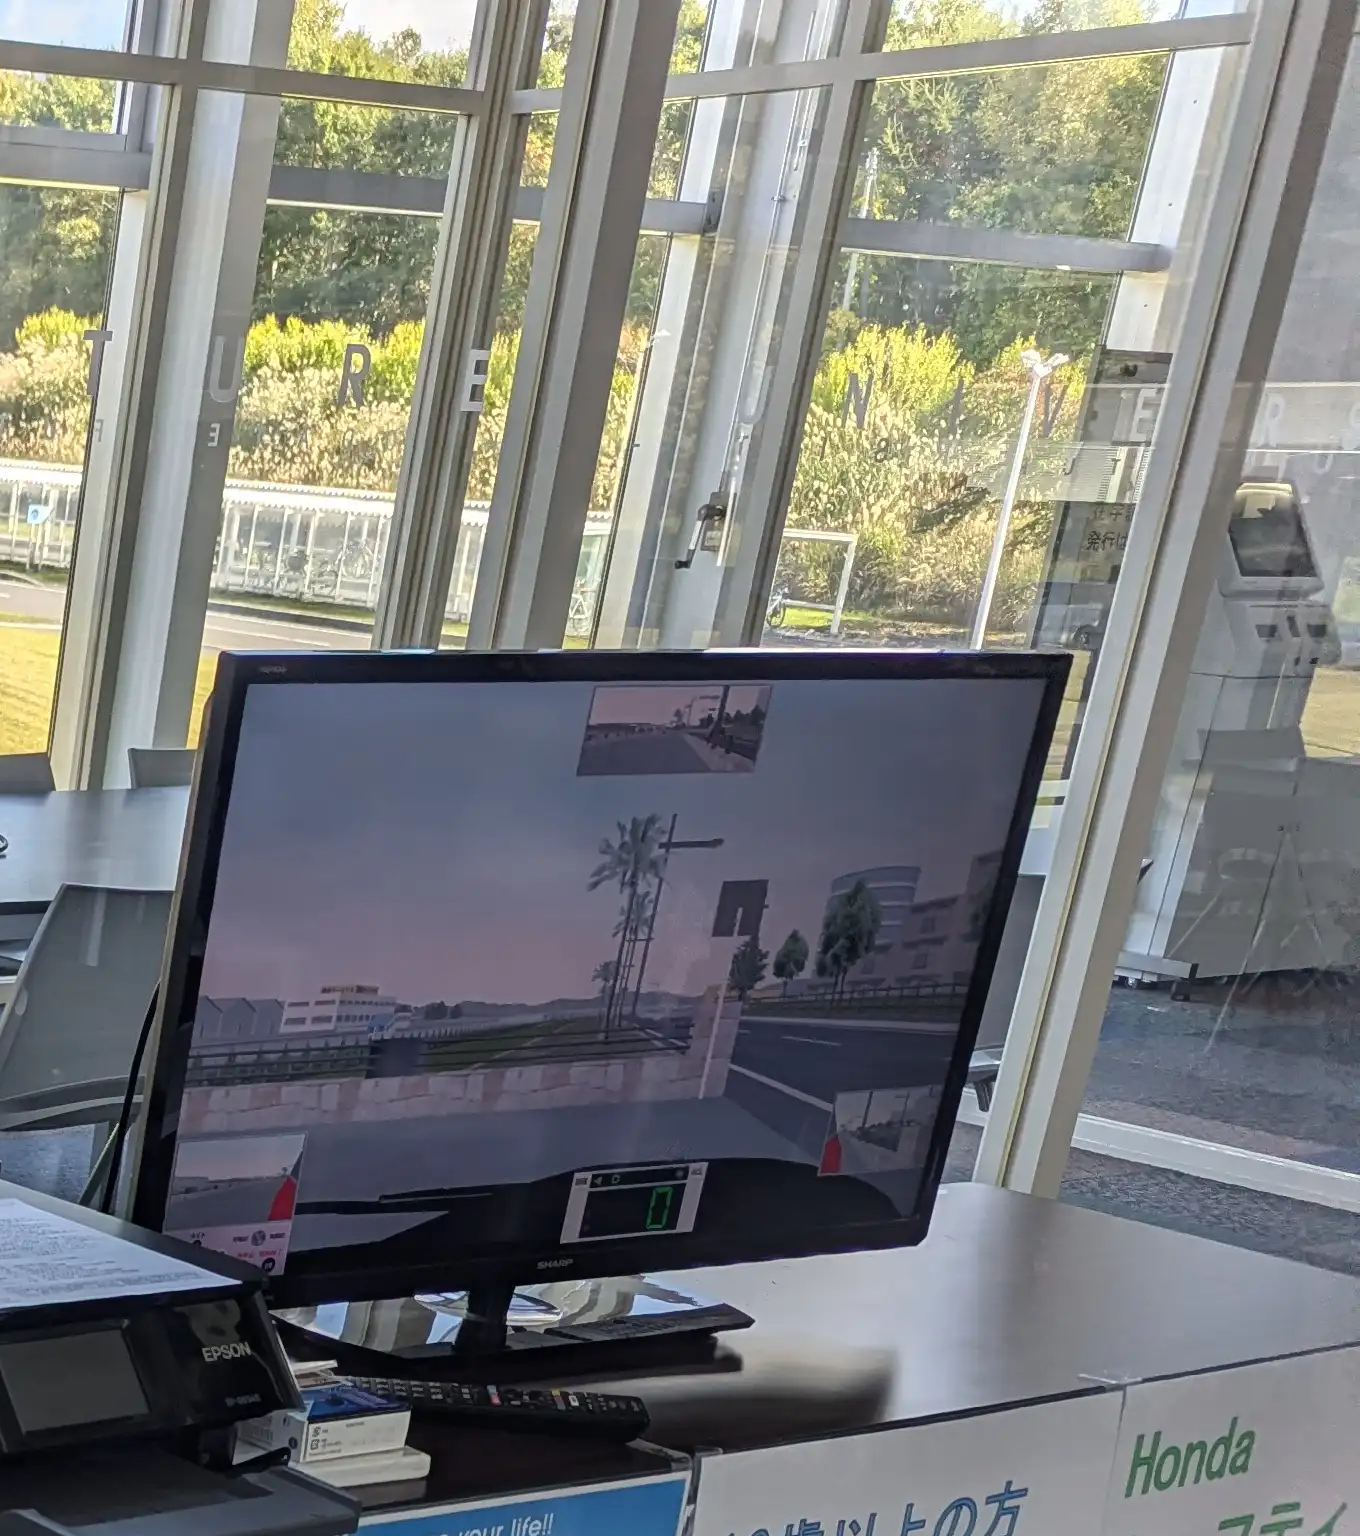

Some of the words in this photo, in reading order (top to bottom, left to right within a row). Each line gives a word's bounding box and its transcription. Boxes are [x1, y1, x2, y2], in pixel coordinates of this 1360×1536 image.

[537, 1258, 575, 1270] SHARP
[201, 1341, 251, 1363] EPSON
[1124, 1416, 1257, 1498] Honda
